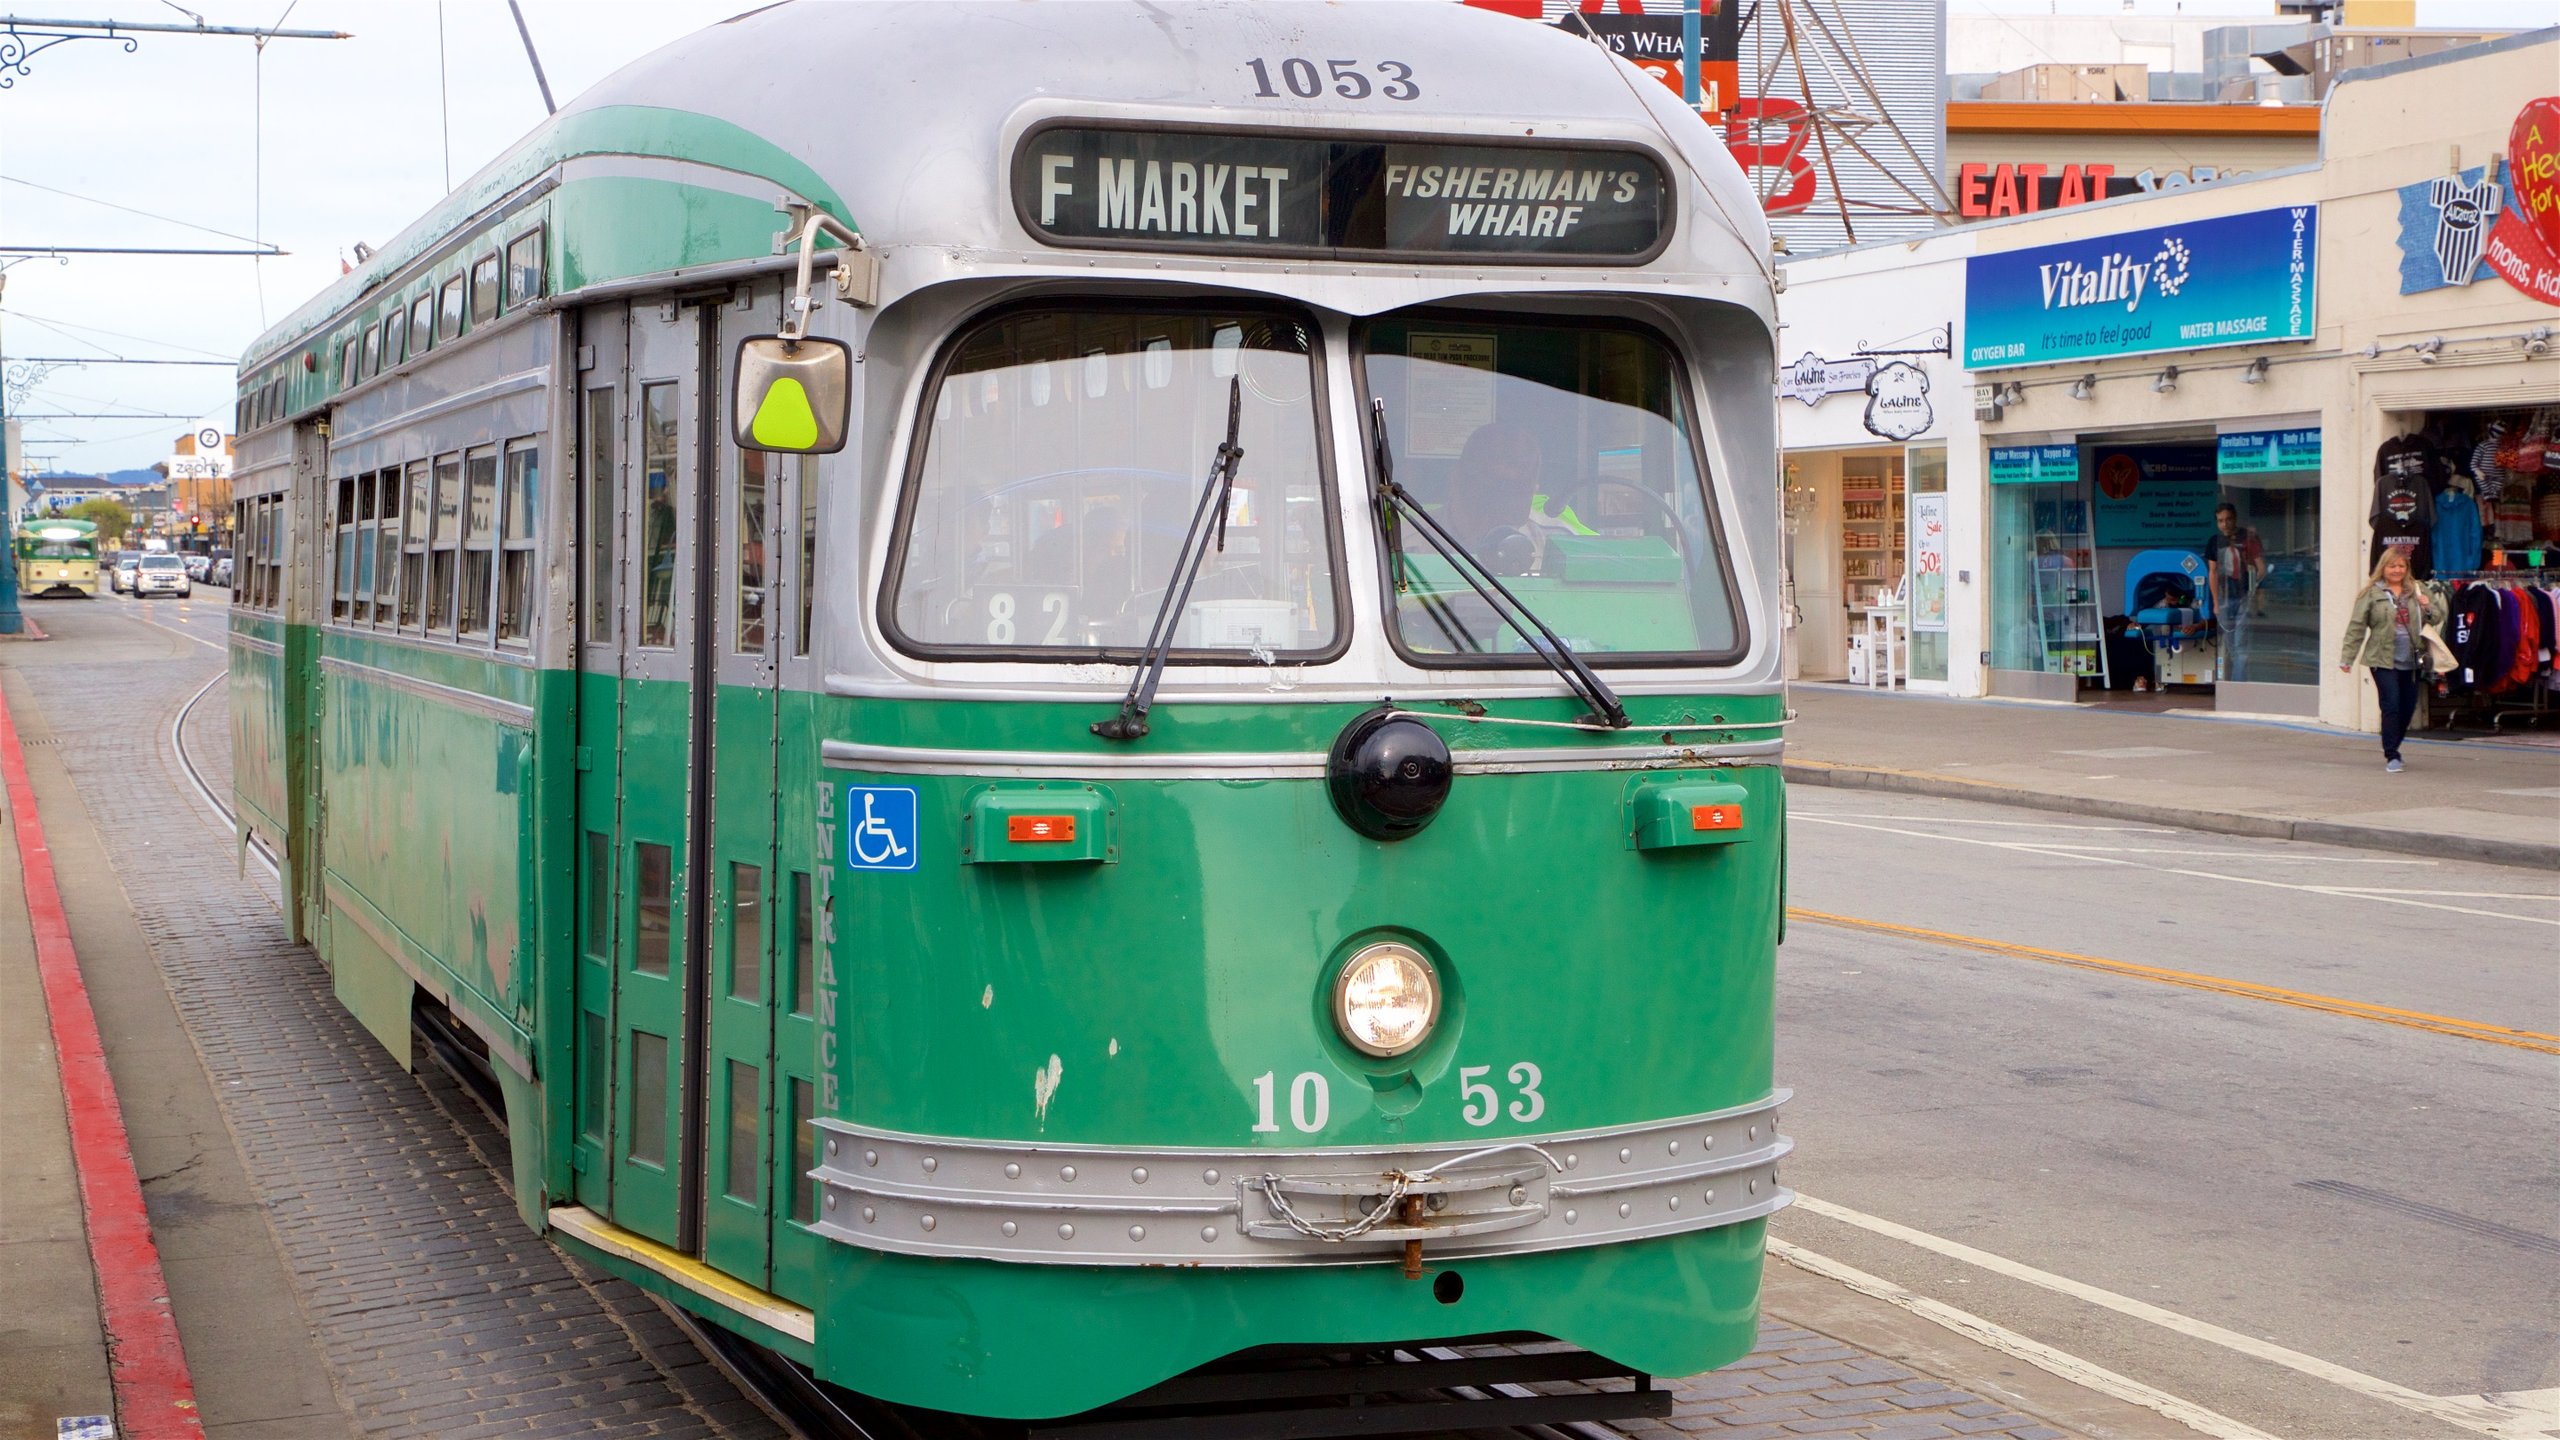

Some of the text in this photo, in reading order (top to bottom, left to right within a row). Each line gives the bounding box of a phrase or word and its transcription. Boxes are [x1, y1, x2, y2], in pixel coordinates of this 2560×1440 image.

[1631, 31, 1710, 54] WHAF
[1246, 57, 1420, 101] 1053
[2526, 124, 2543, 151] A
[1041, 154, 1289, 239] F MARKET
[1385, 164, 1640, 204] FISHERMAN'S
[1961, 163, 2048, 217] EAT
[2056, 164, 2115, 209] AT
[2446, 203, 2479, 223] Alcatraz
[2530, 184, 2554, 219] for
[1448, 203, 1584, 238] WHARF
[2488, 236, 2531, 288] moms,
[2038, 252, 2153, 313] Vitality
[2041, 320, 2152, 351] It's time to feel good
[2180, 316, 2268, 340] WATER MASSAGE
[1971, 343, 2025, 361] OXYGEN BAR
[1976, 388, 1991, 397] BAY
[2221, 434, 2265, 447] Revitalize Your
[2283, 433, 2298, 445] Body
[1994, 449, 2030, 460] Water Massage
[2043, 447, 2072, 459] Oxygen Bar
[1926, 520, 1942, 537] Sale
[2382, 536, 2420, 545] ALCATRAZ
[2457, 613, 2466, 629] I
[815, 780, 839, 1112] ENTRANCE
[1251, 1060, 1546, 1134] 10 53
